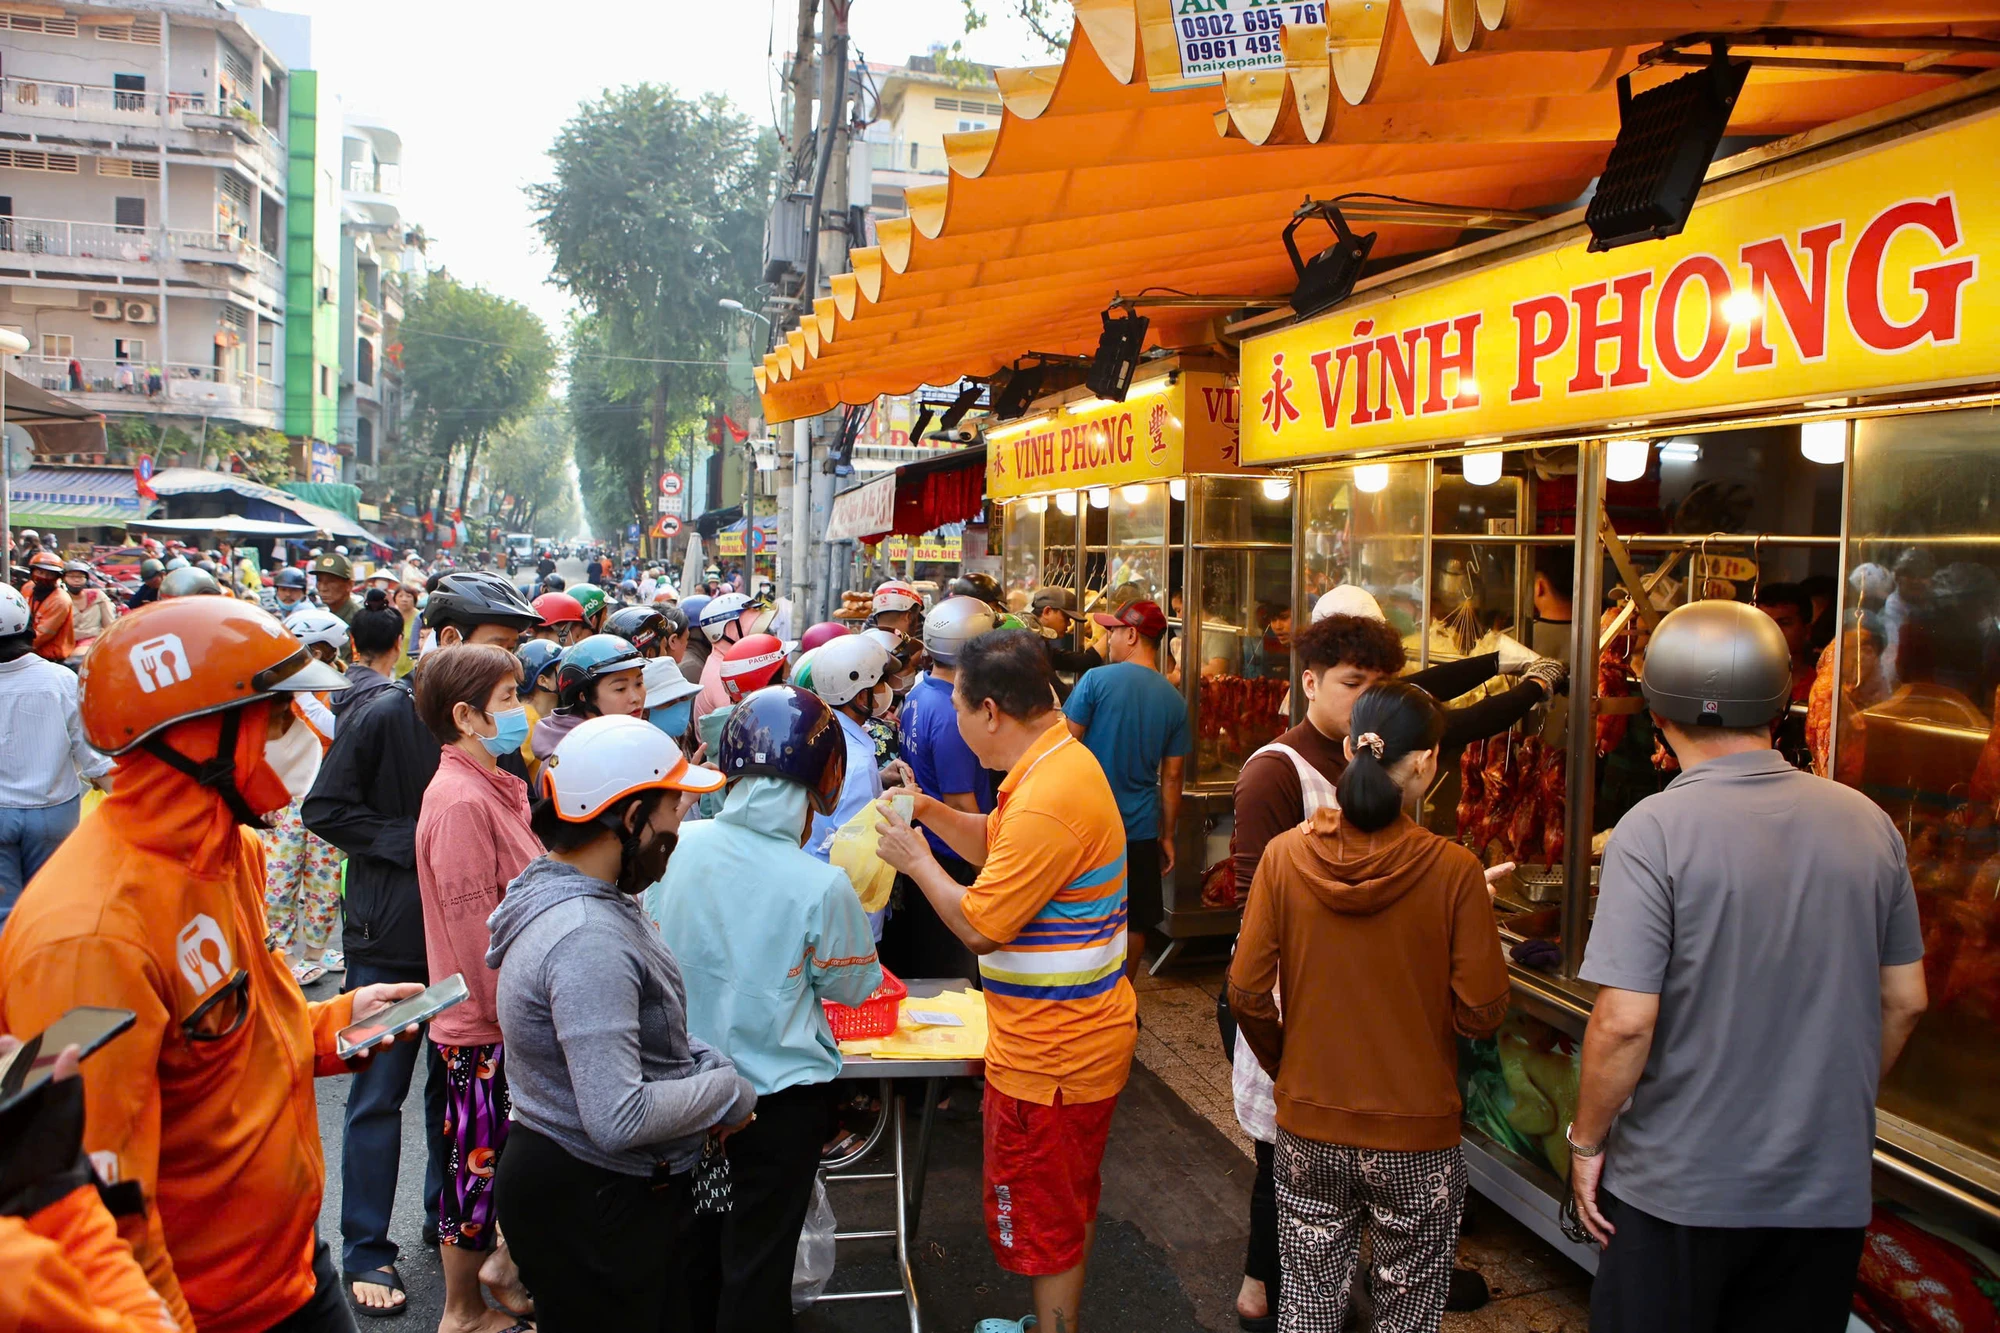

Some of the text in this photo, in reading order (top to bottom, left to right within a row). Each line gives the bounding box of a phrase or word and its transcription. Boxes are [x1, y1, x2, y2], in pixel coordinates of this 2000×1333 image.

[1181, 3, 1326, 38] 0902 695 761
[1186, 40, 1237, 61] 0961
[1187, 54, 1284, 73] maixepanta
[1312, 195, 1975, 429] VĨNH PHONG
[1261, 353, 1300, 433] 永
[1061, 413, 1134, 472] PHONG
[748, 653, 776, 665] PACIFIC
